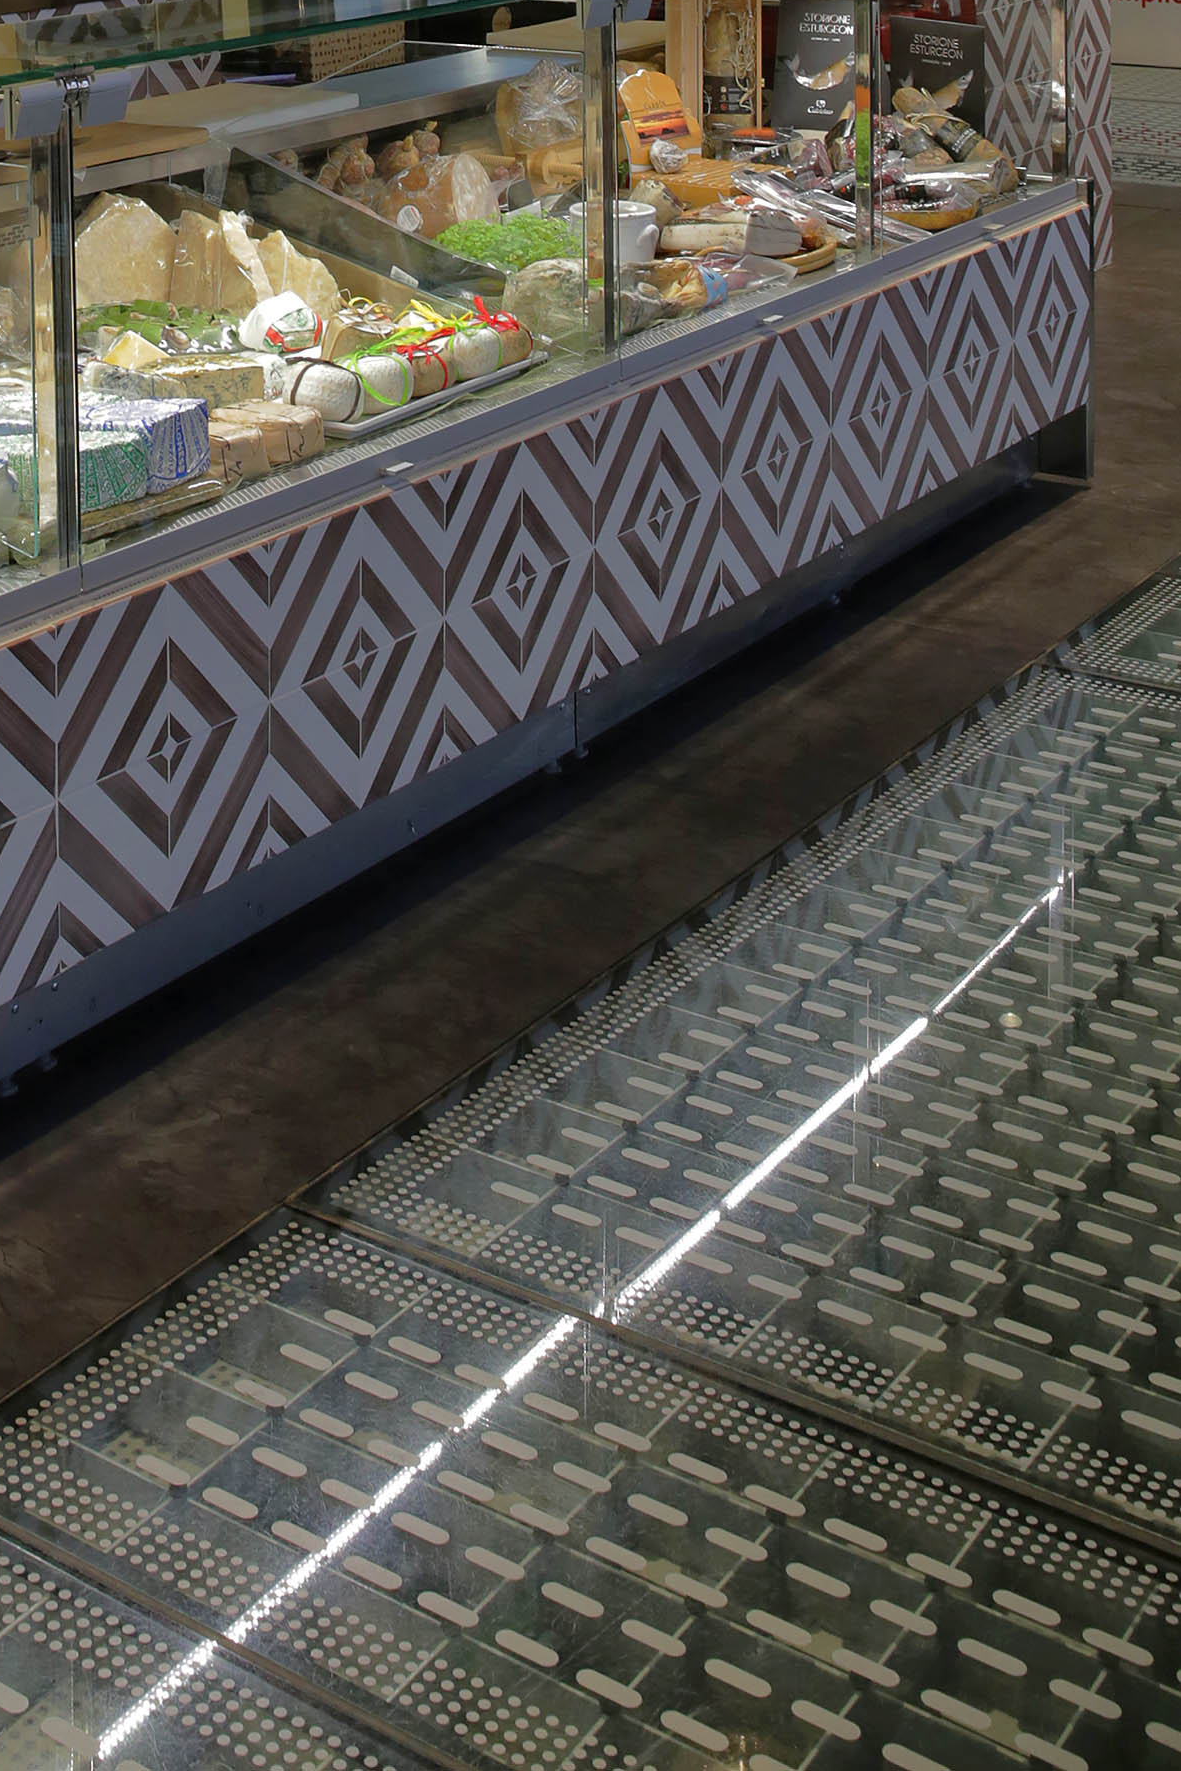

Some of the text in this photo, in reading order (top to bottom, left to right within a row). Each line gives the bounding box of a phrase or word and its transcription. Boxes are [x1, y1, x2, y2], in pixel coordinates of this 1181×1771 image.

[804, 12, 851, 26] STORIONE
[799, 22, 854, 36] ESTURGEON
[914, 33, 960, 50] STORIONE
[909, 43, 964, 61] ESTURGEON
